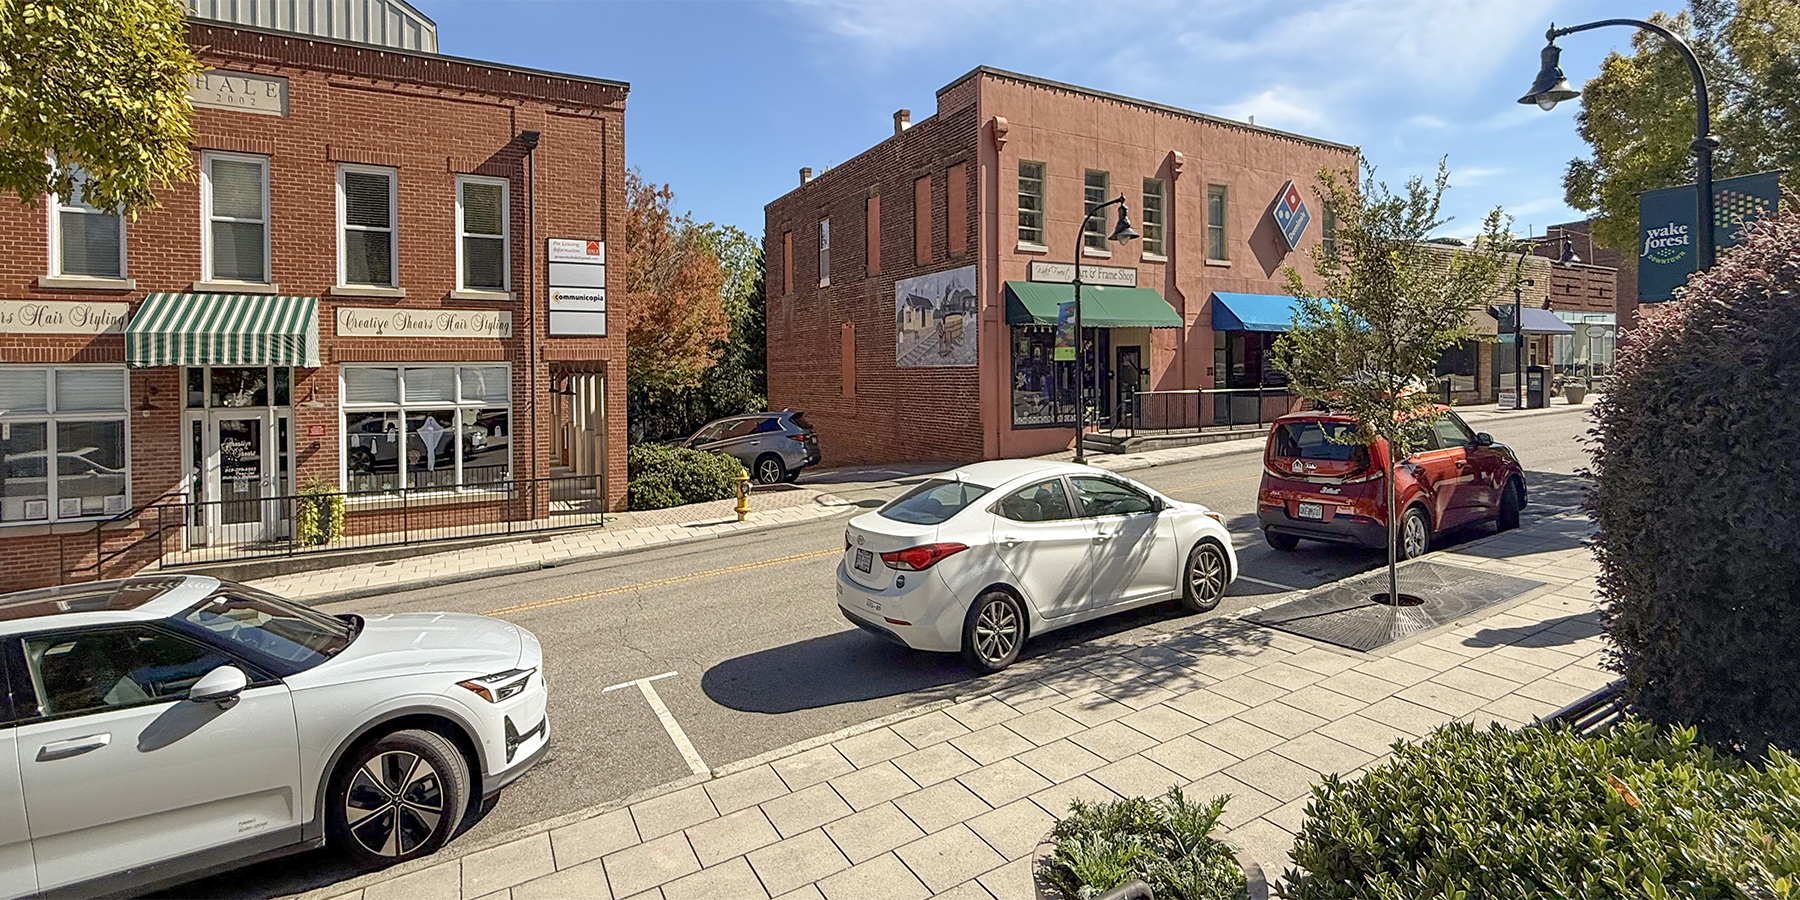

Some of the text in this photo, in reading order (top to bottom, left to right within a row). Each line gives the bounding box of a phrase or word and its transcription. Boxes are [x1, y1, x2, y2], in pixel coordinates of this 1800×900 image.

[196, 74, 278, 98] HALE
[216, 93, 256, 106] 2002
[1646, 222, 1688, 239] wake
[1640, 234, 1690, 257] forest
[1647, 250, 1686, 264] DOWNTOWN
[1090, 266, 1097, 279] &
[1098, 267, 1118, 280] Frame
[1118, 269, 1134, 284] Shop
[552, 292, 604, 303] communicopia
[18, 303, 64, 328] Hair
[69, 303, 125, 332] Styling
[340, 309, 510, 335] Creative Shears Hair Styling
